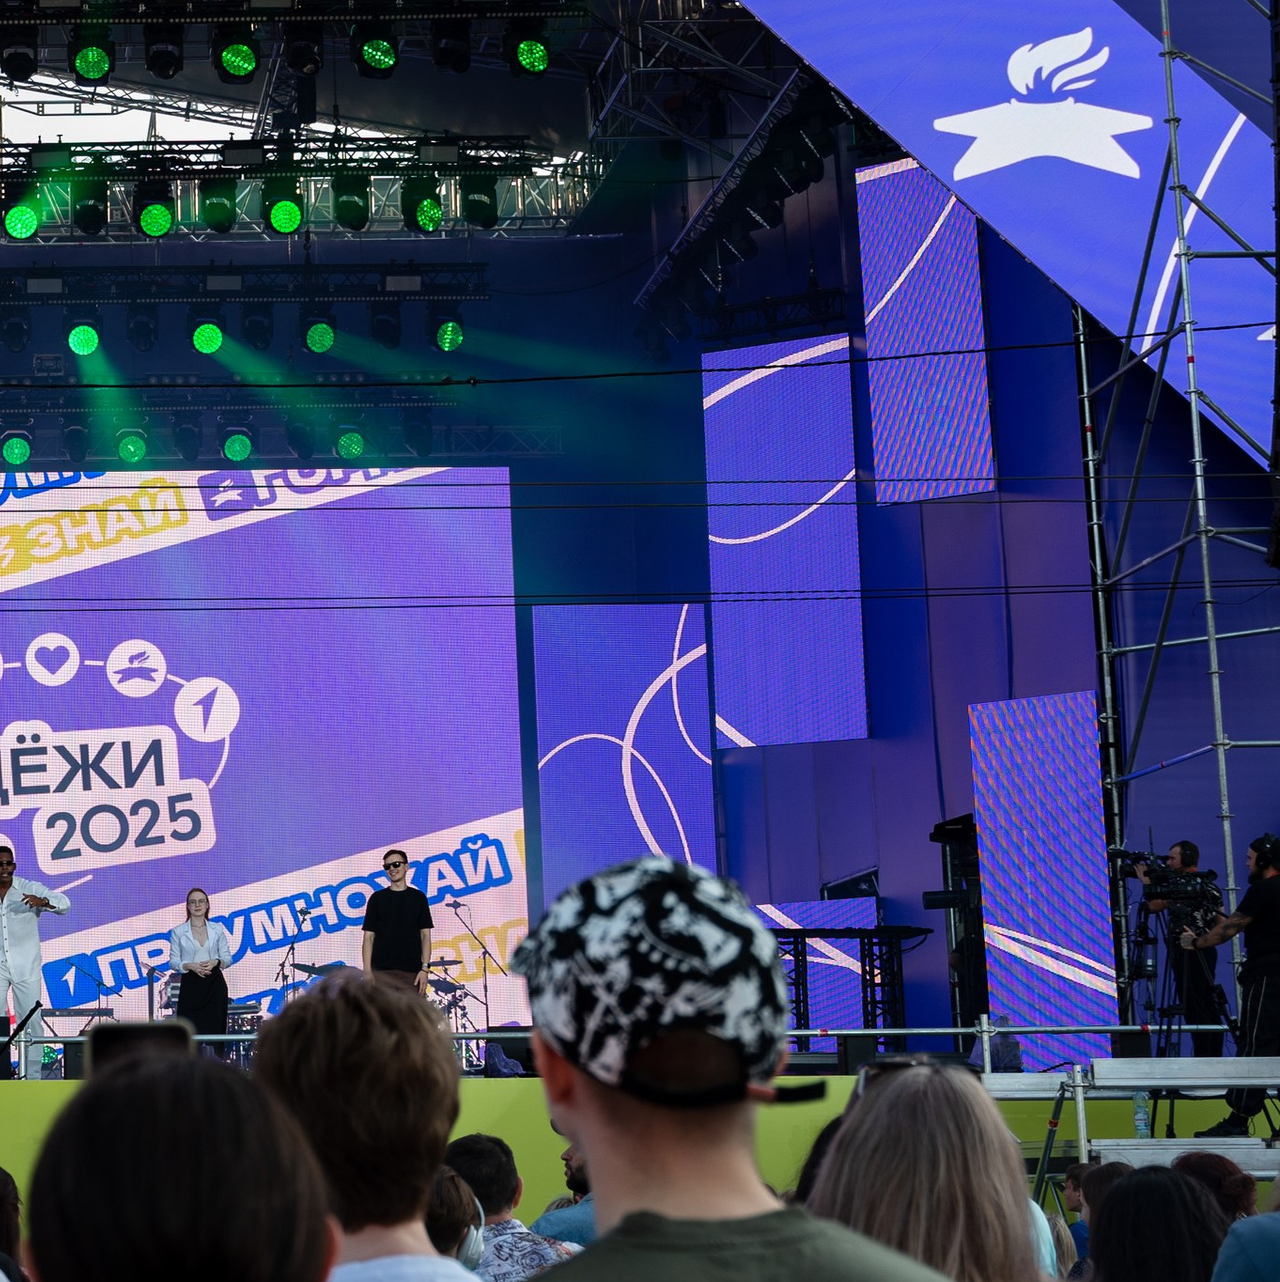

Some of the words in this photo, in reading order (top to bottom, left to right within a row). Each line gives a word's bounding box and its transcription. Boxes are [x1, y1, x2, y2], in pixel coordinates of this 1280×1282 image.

[23, 484, 183, 559] ЗНАЙ
[45, 792, 203, 861] 2025
[96, 839, 505, 987] ПРУМНОАЙ
